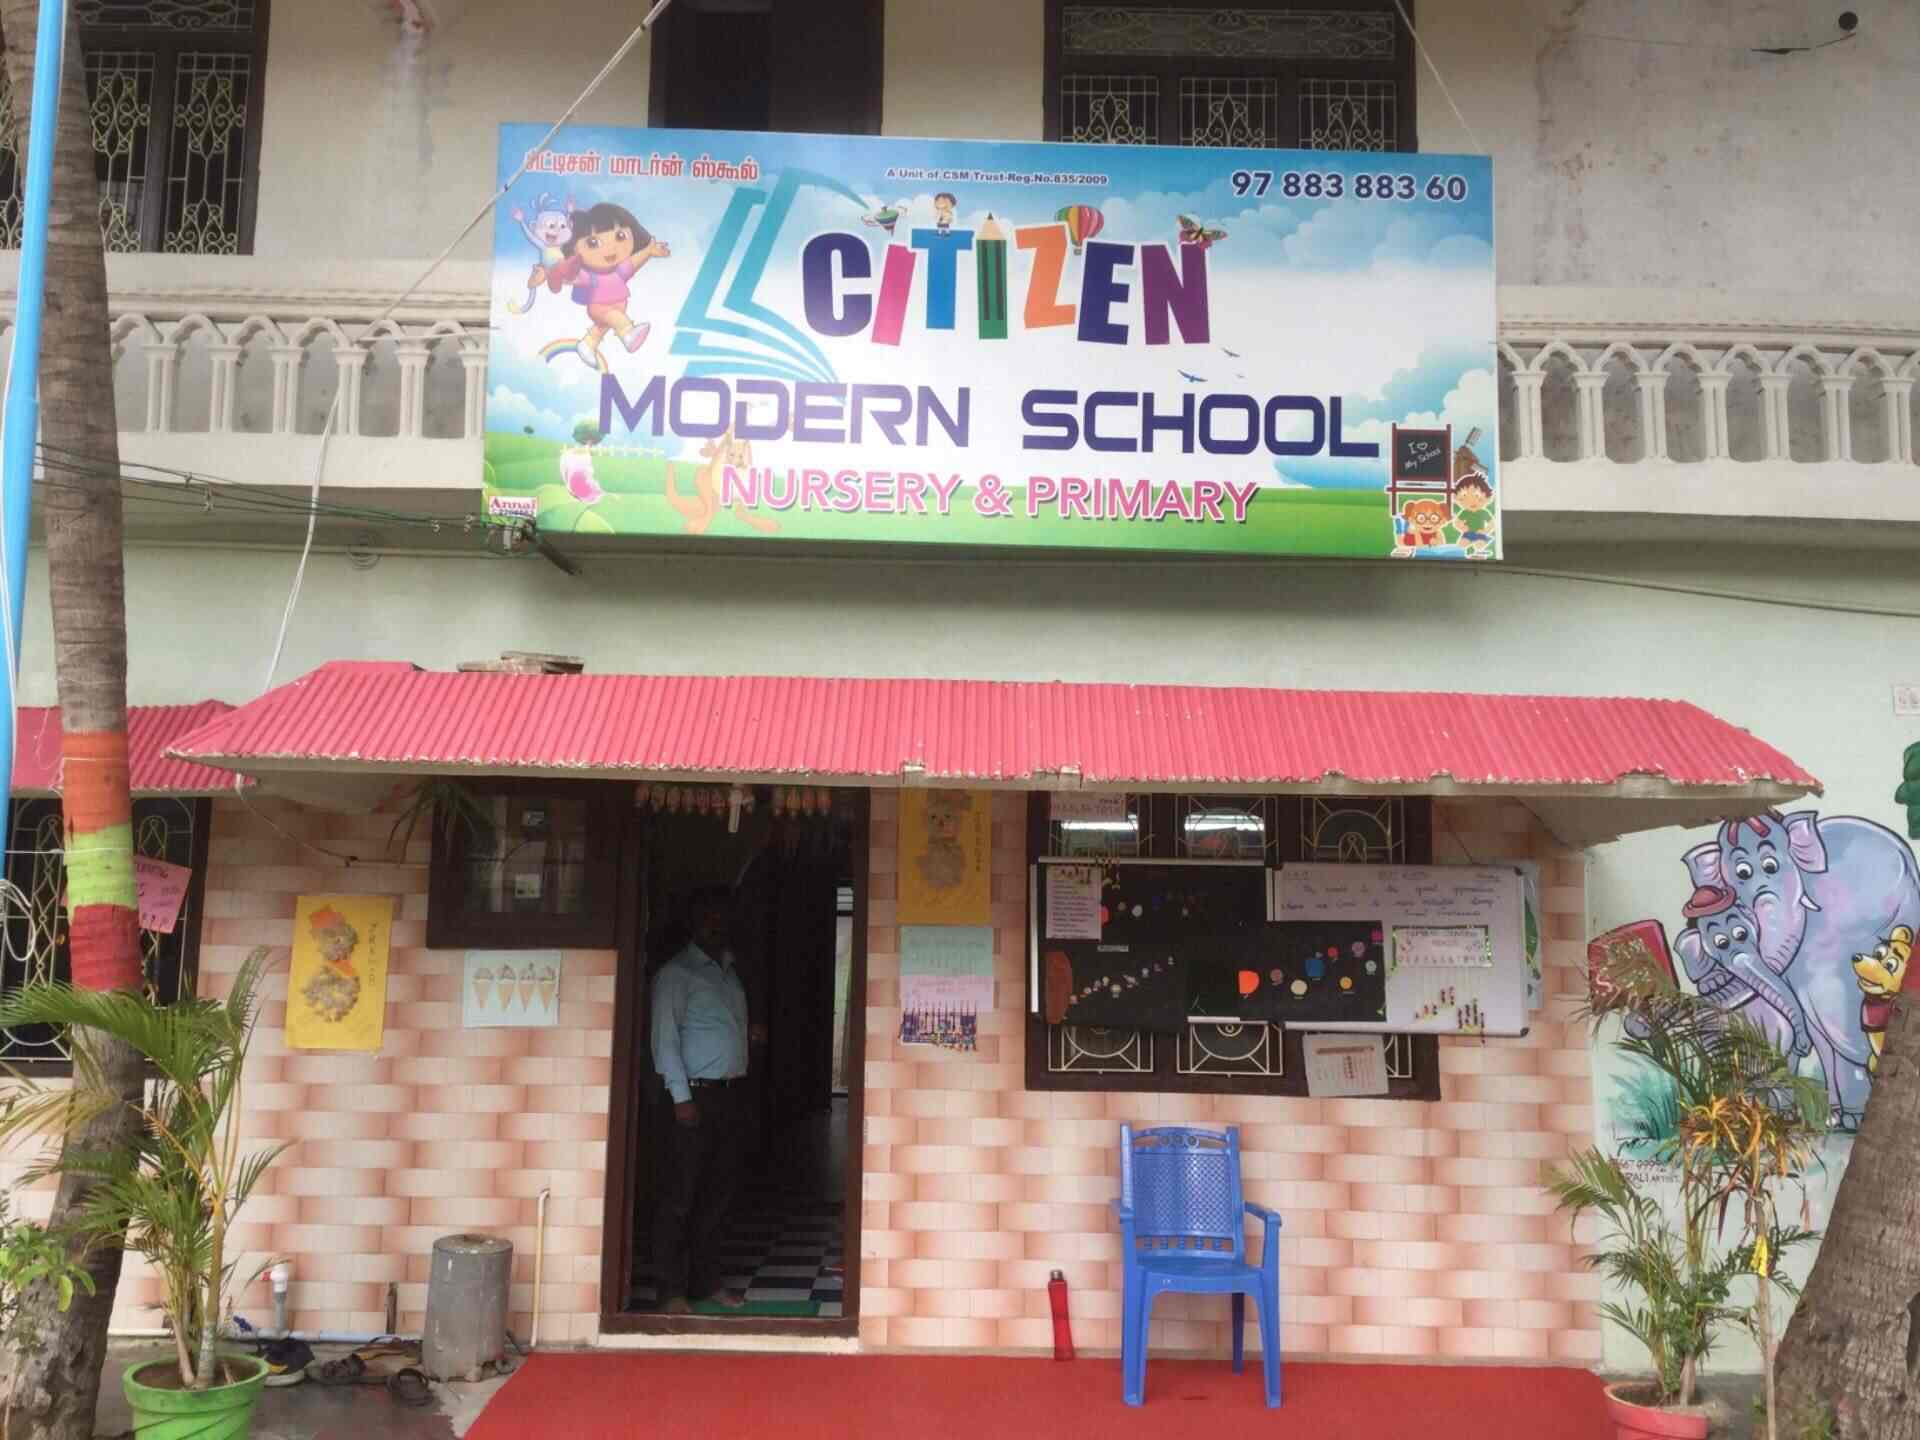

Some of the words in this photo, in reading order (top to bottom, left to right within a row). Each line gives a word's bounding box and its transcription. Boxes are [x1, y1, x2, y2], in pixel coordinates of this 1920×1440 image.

[611, 153, 683, 176] மாடர்ன்
[693, 154, 758, 180] ஸ்கூல்
[886, 169, 896, 178] A
[900, 169, 924, 179] Unit
[927, 170, 938, 179] of
[943, 171, 969, 181] CSM
[1231, 171, 1272, 196] 97
[1283, 172, 1344, 198] 883
[1354, 174, 1417, 199] 883
[1425, 175, 1467, 201] 60
[802, 217, 1213, 346] CITIZEN
[600, 373, 970, 448] MODERN
[1021, 389, 1380, 458] SCHOOL
[721, 465, 961, 514] NURSERY
[974, 474, 1010, 515] &
[1026, 475, 1257, 522] PRIMARY
